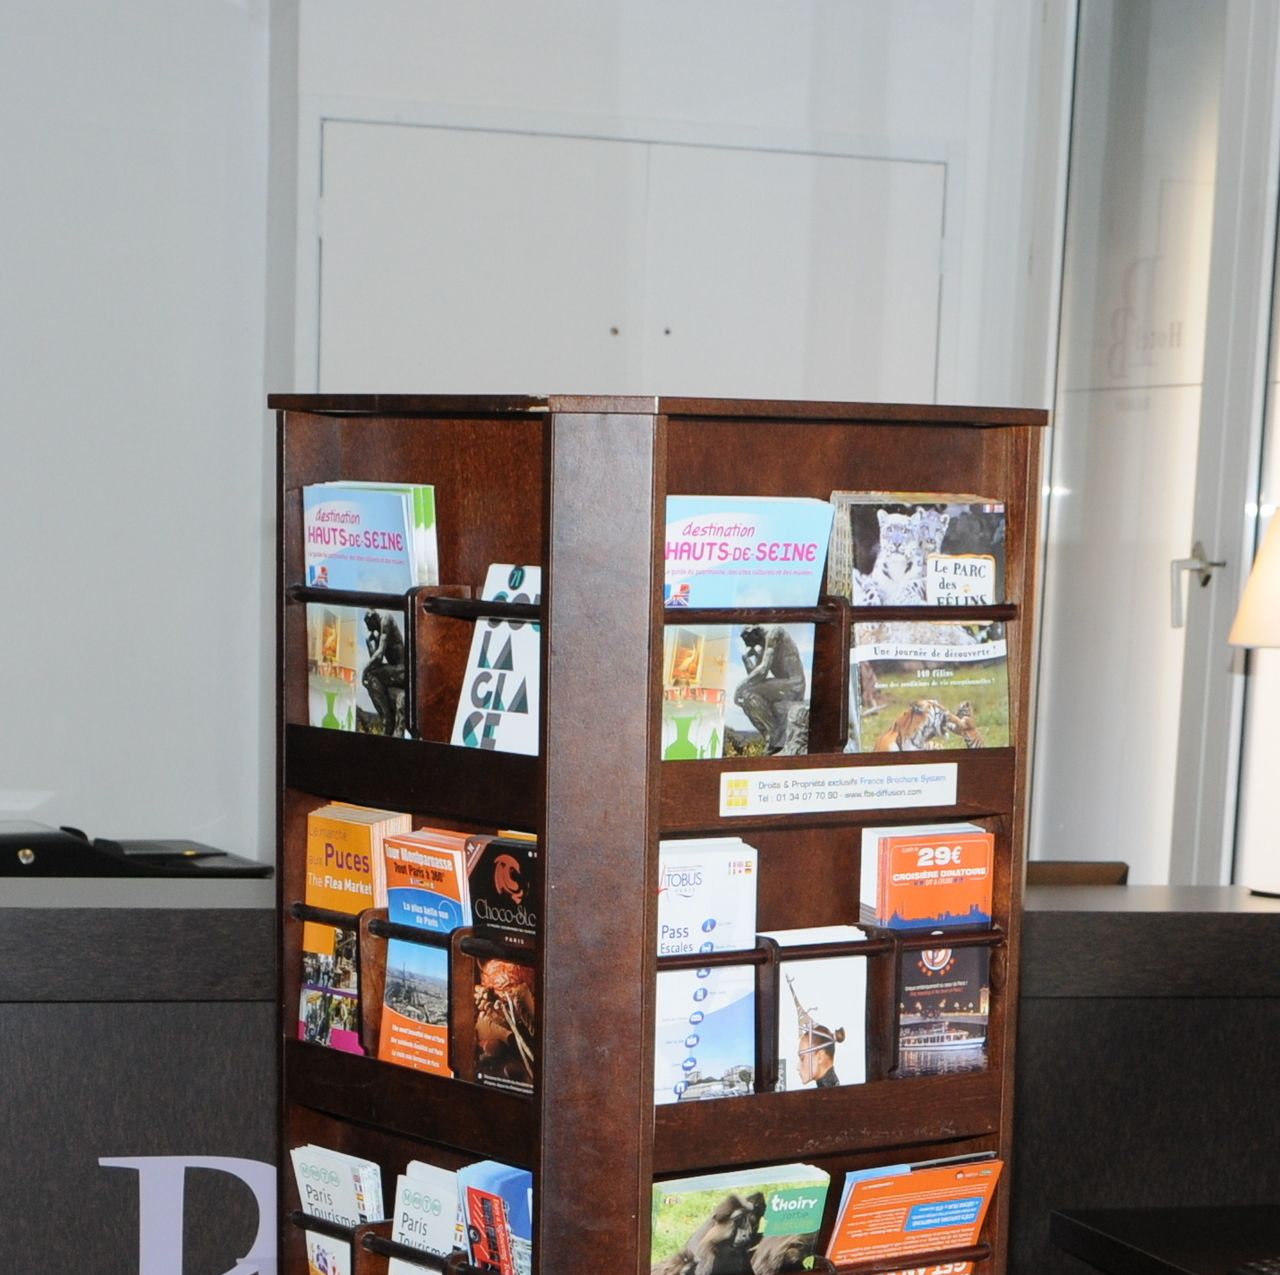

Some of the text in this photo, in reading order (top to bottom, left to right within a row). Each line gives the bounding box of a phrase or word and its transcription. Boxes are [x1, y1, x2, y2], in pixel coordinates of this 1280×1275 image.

[315, 508, 361, 524] destination
[307, 525, 404, 552] HAUTS-DE-SEINE
[682, 522, 755, 538] destination
[664, 542, 818, 562] HAUTS-DE-SEINE
[934, 560, 987, 579] Le PARC
[938, 578, 957, 590] des
[873, 646, 891, 656] Une
[894, 646, 927, 658] journée
[931, 649, 941, 658] de
[944, 648, 990, 658] découverte
[324, 842, 370, 873] Puces
[916, 845, 962, 867] 29€
[308, 872, 372, 896] The Flea Market
[661, 925, 689, 939] Pass
[660, 942, 693, 955] Escales
[305, 1184, 333, 1206] Paris
[401, 1212, 428, 1237] Paris
